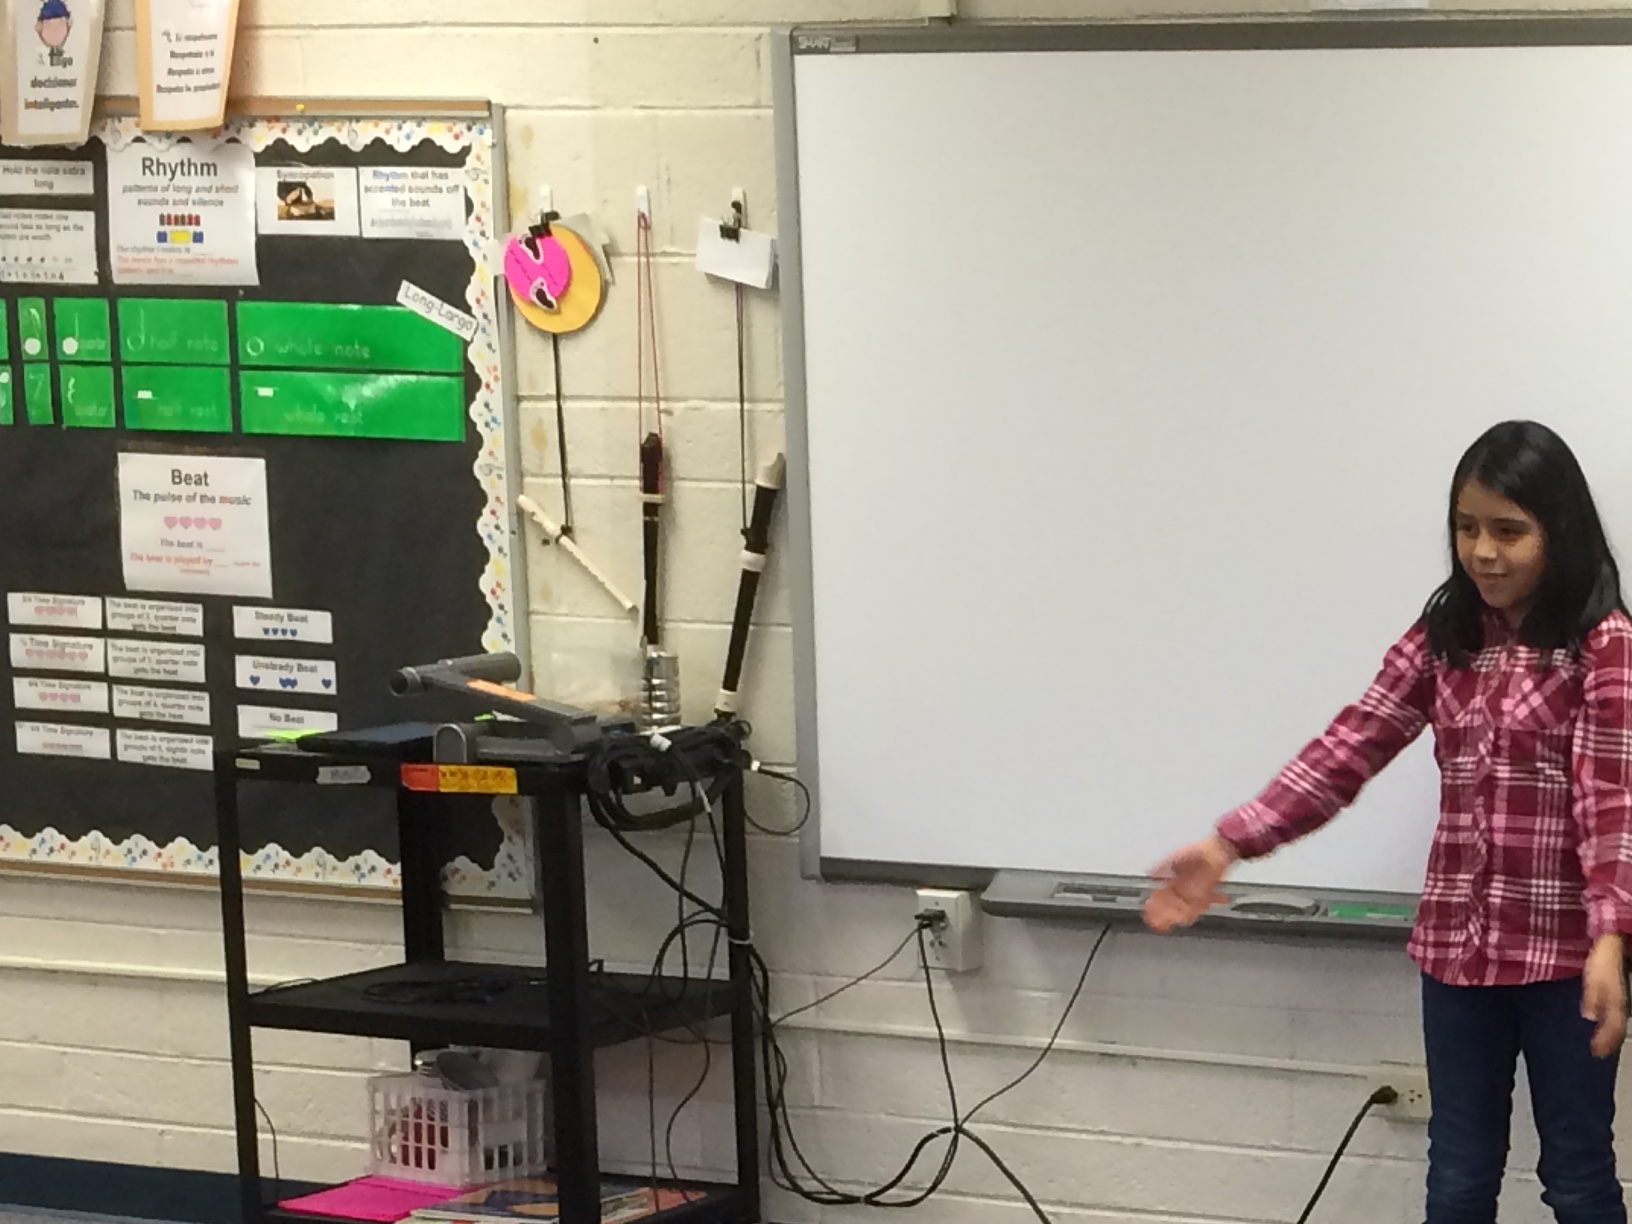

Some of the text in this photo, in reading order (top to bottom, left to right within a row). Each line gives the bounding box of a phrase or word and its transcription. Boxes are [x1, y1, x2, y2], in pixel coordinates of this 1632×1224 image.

[141, 157, 218, 181] Rhythm
[172, 184, 192, 194] long
[195, 185, 213, 193] and
[409, 198, 430, 207] beat
[171, 469, 209, 486] Beat
[133, 490, 150, 501] The
[154, 492, 182, 503] pulse
[185, 493, 196, 503] of
[200, 493, 216, 503] the
